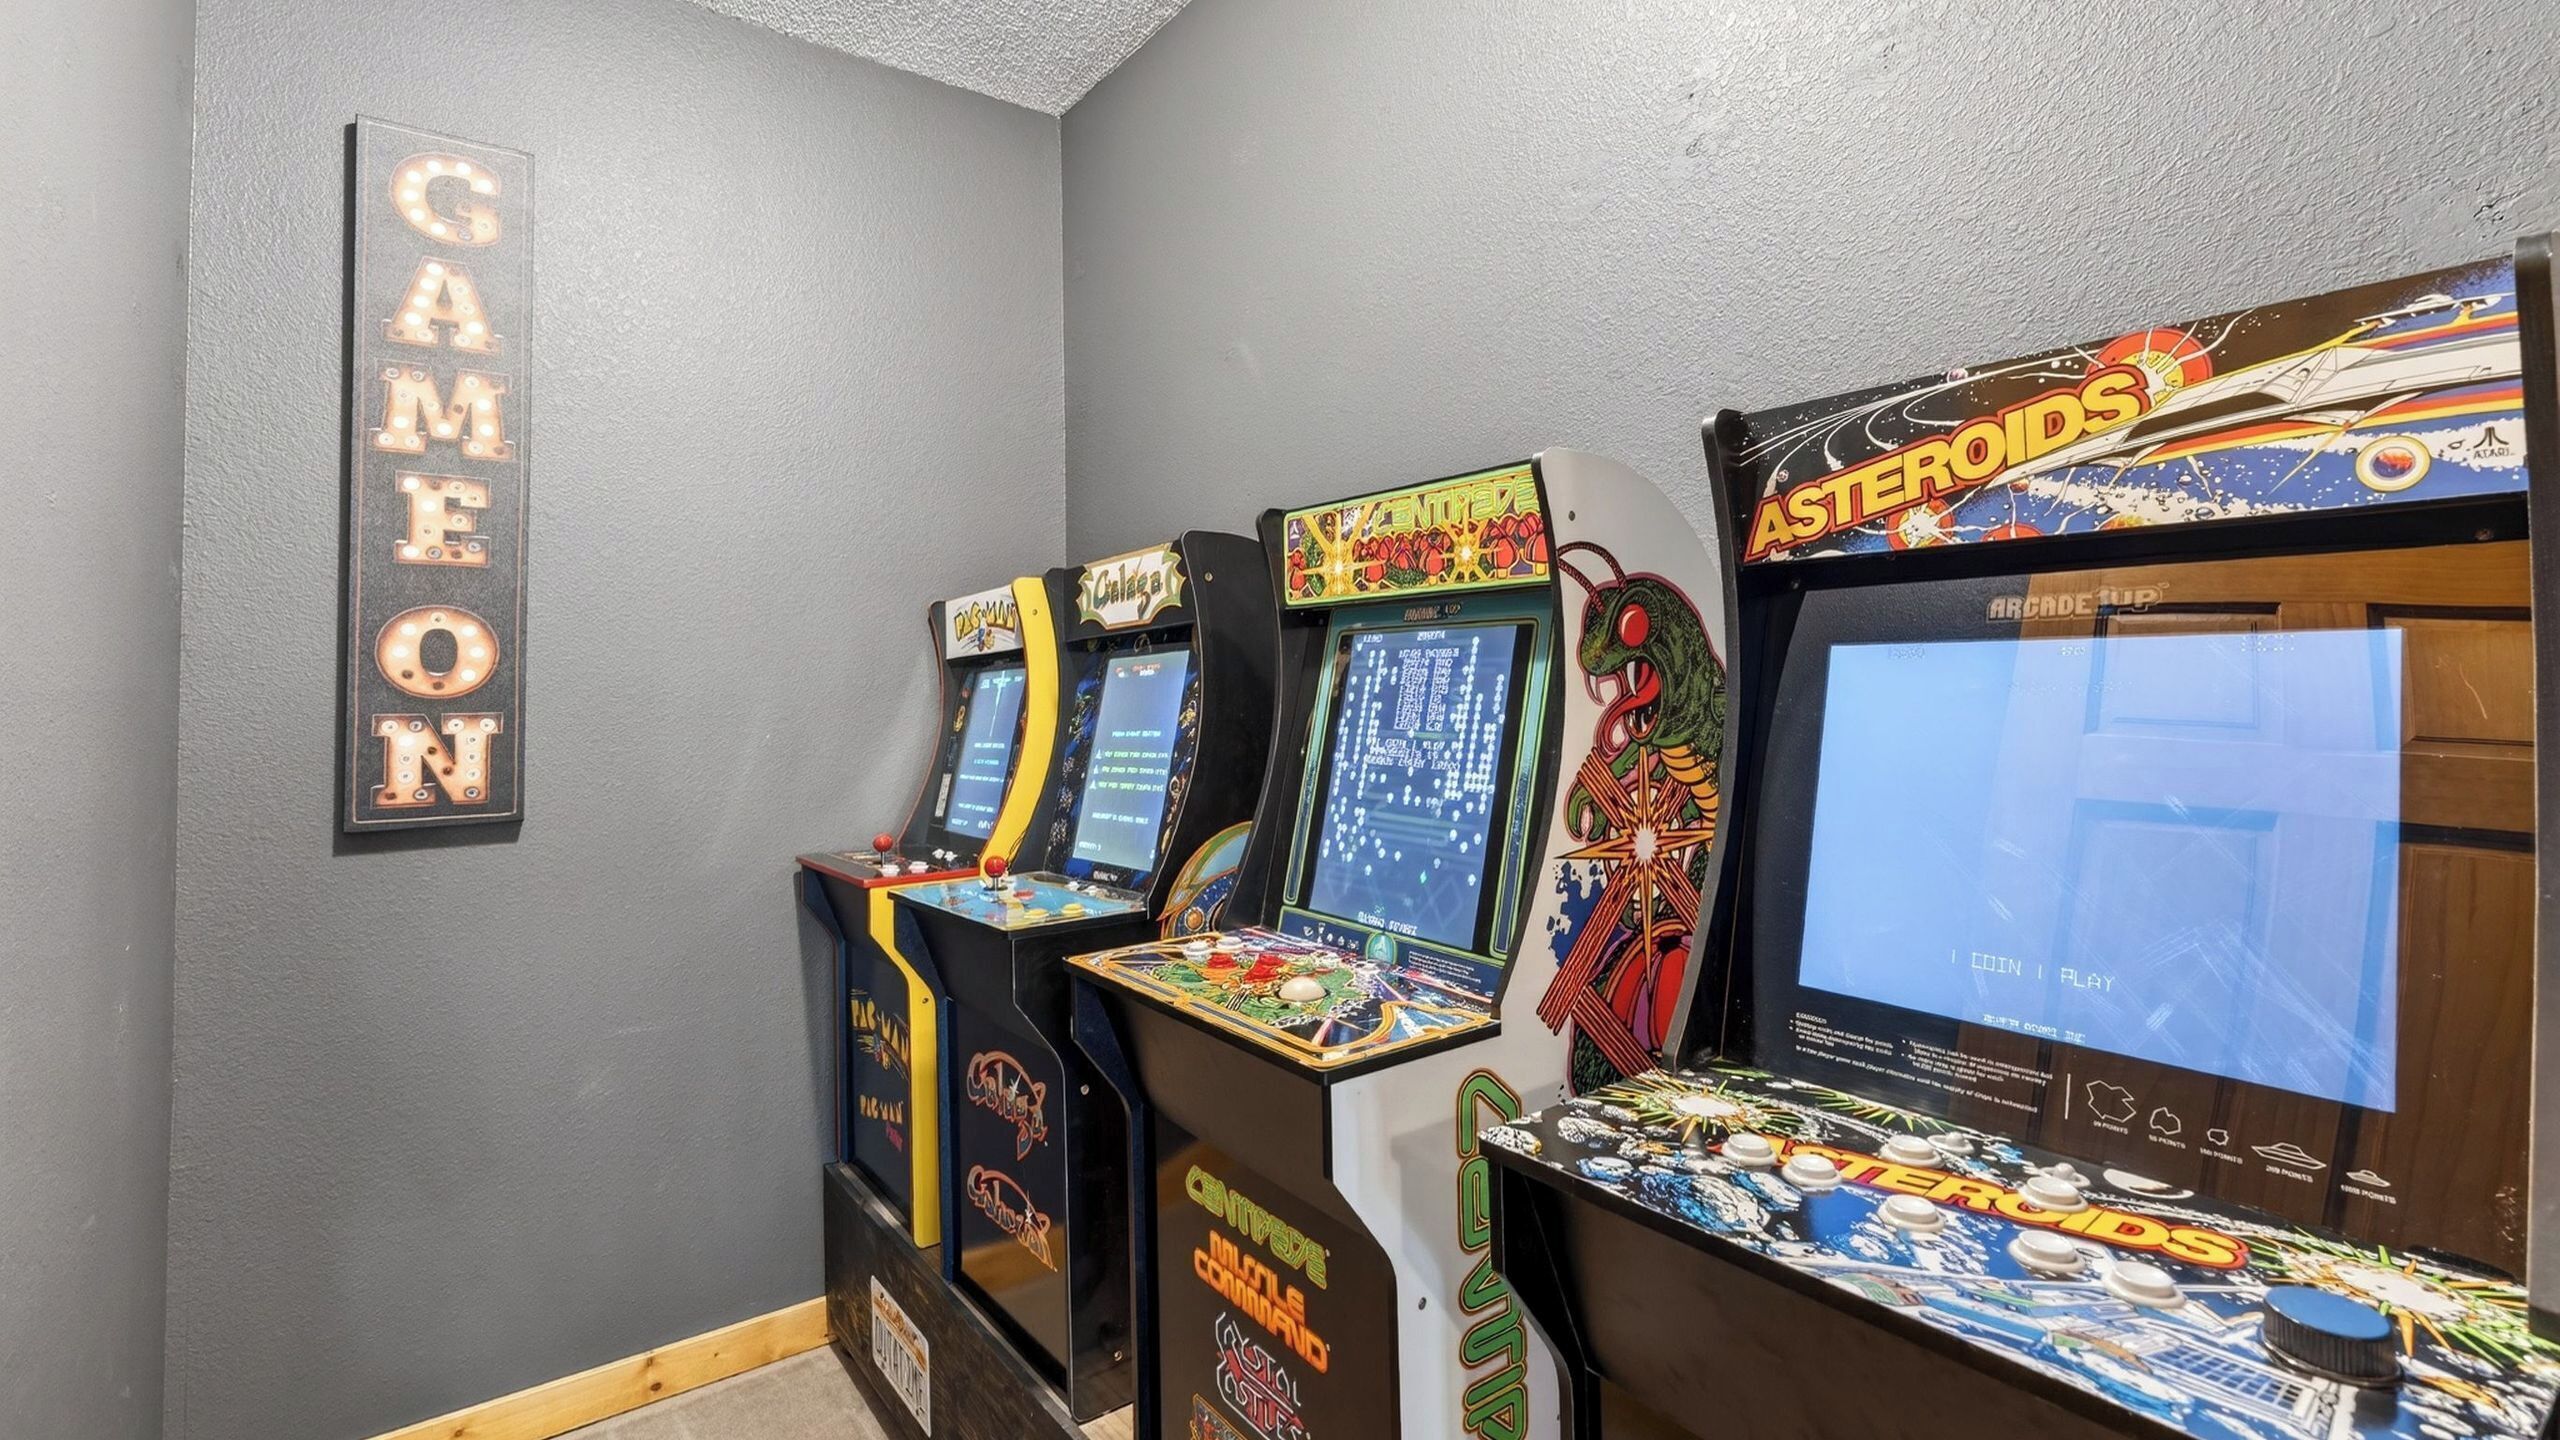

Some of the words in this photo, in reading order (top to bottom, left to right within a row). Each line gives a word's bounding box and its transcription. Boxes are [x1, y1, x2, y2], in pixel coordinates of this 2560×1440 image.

[370, 151, 516, 568] GAME
[1745, 363, 2152, 561] ASTEROIDS
[1093, 562, 1164, 620] Galaga
[370, 605, 504, 811] ON
[1971, 951, 2022, 977] COIN
[2060, 966, 2116, 993] PLAY
[1185, 1164, 1329, 1290] CENTIPEDE
[1209, 1229, 1305, 1324] MISSILE
[1194, 1247, 1329, 1374] COMMAND
